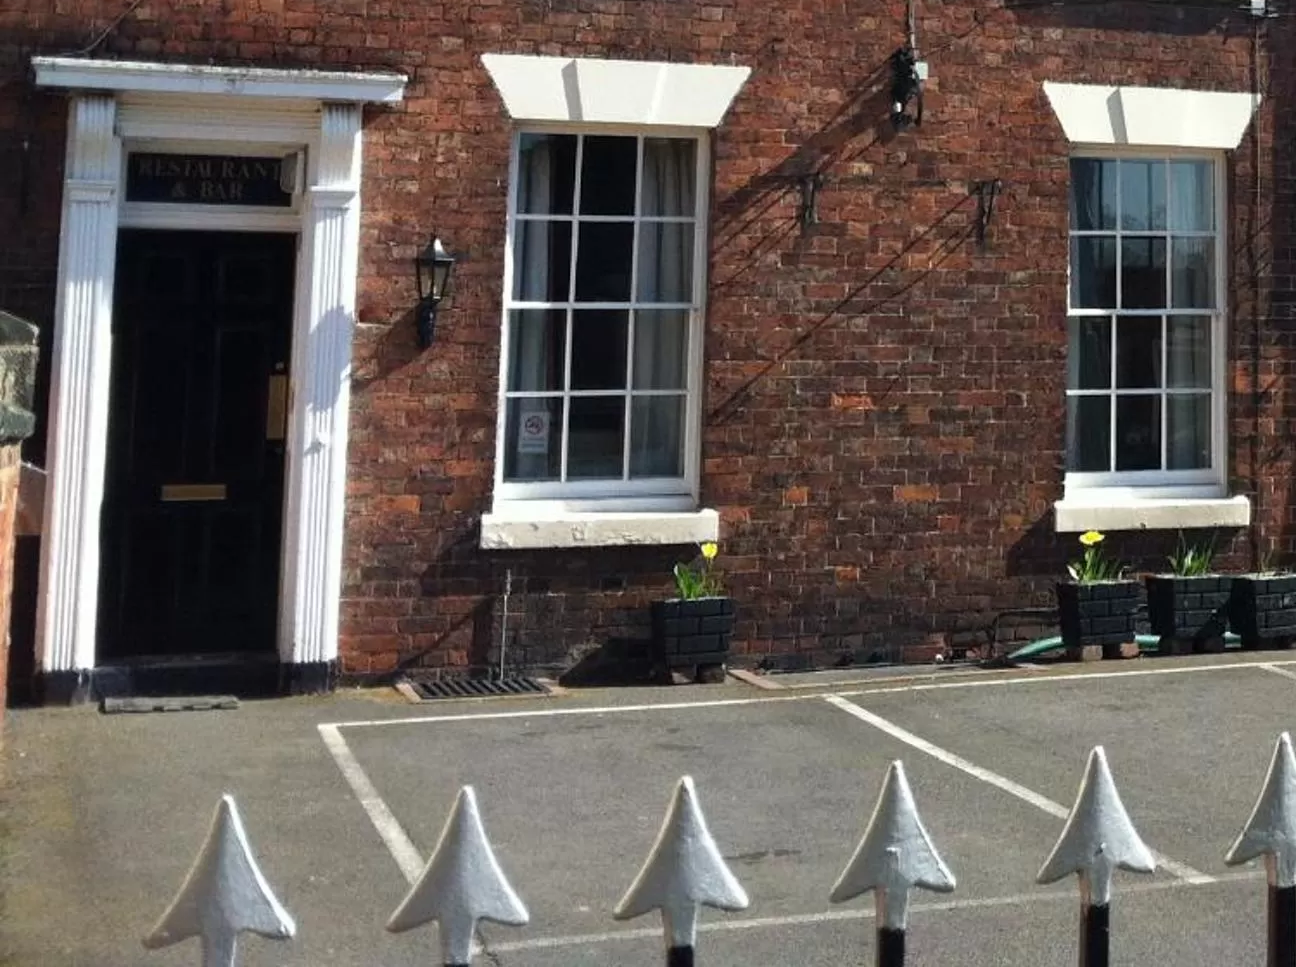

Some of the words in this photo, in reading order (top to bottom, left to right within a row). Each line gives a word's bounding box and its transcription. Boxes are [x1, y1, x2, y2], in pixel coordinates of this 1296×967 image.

[138, 157, 281, 181] RESTAURANT
[172, 182, 188, 199] &
[200, 180, 244, 201] BAR
